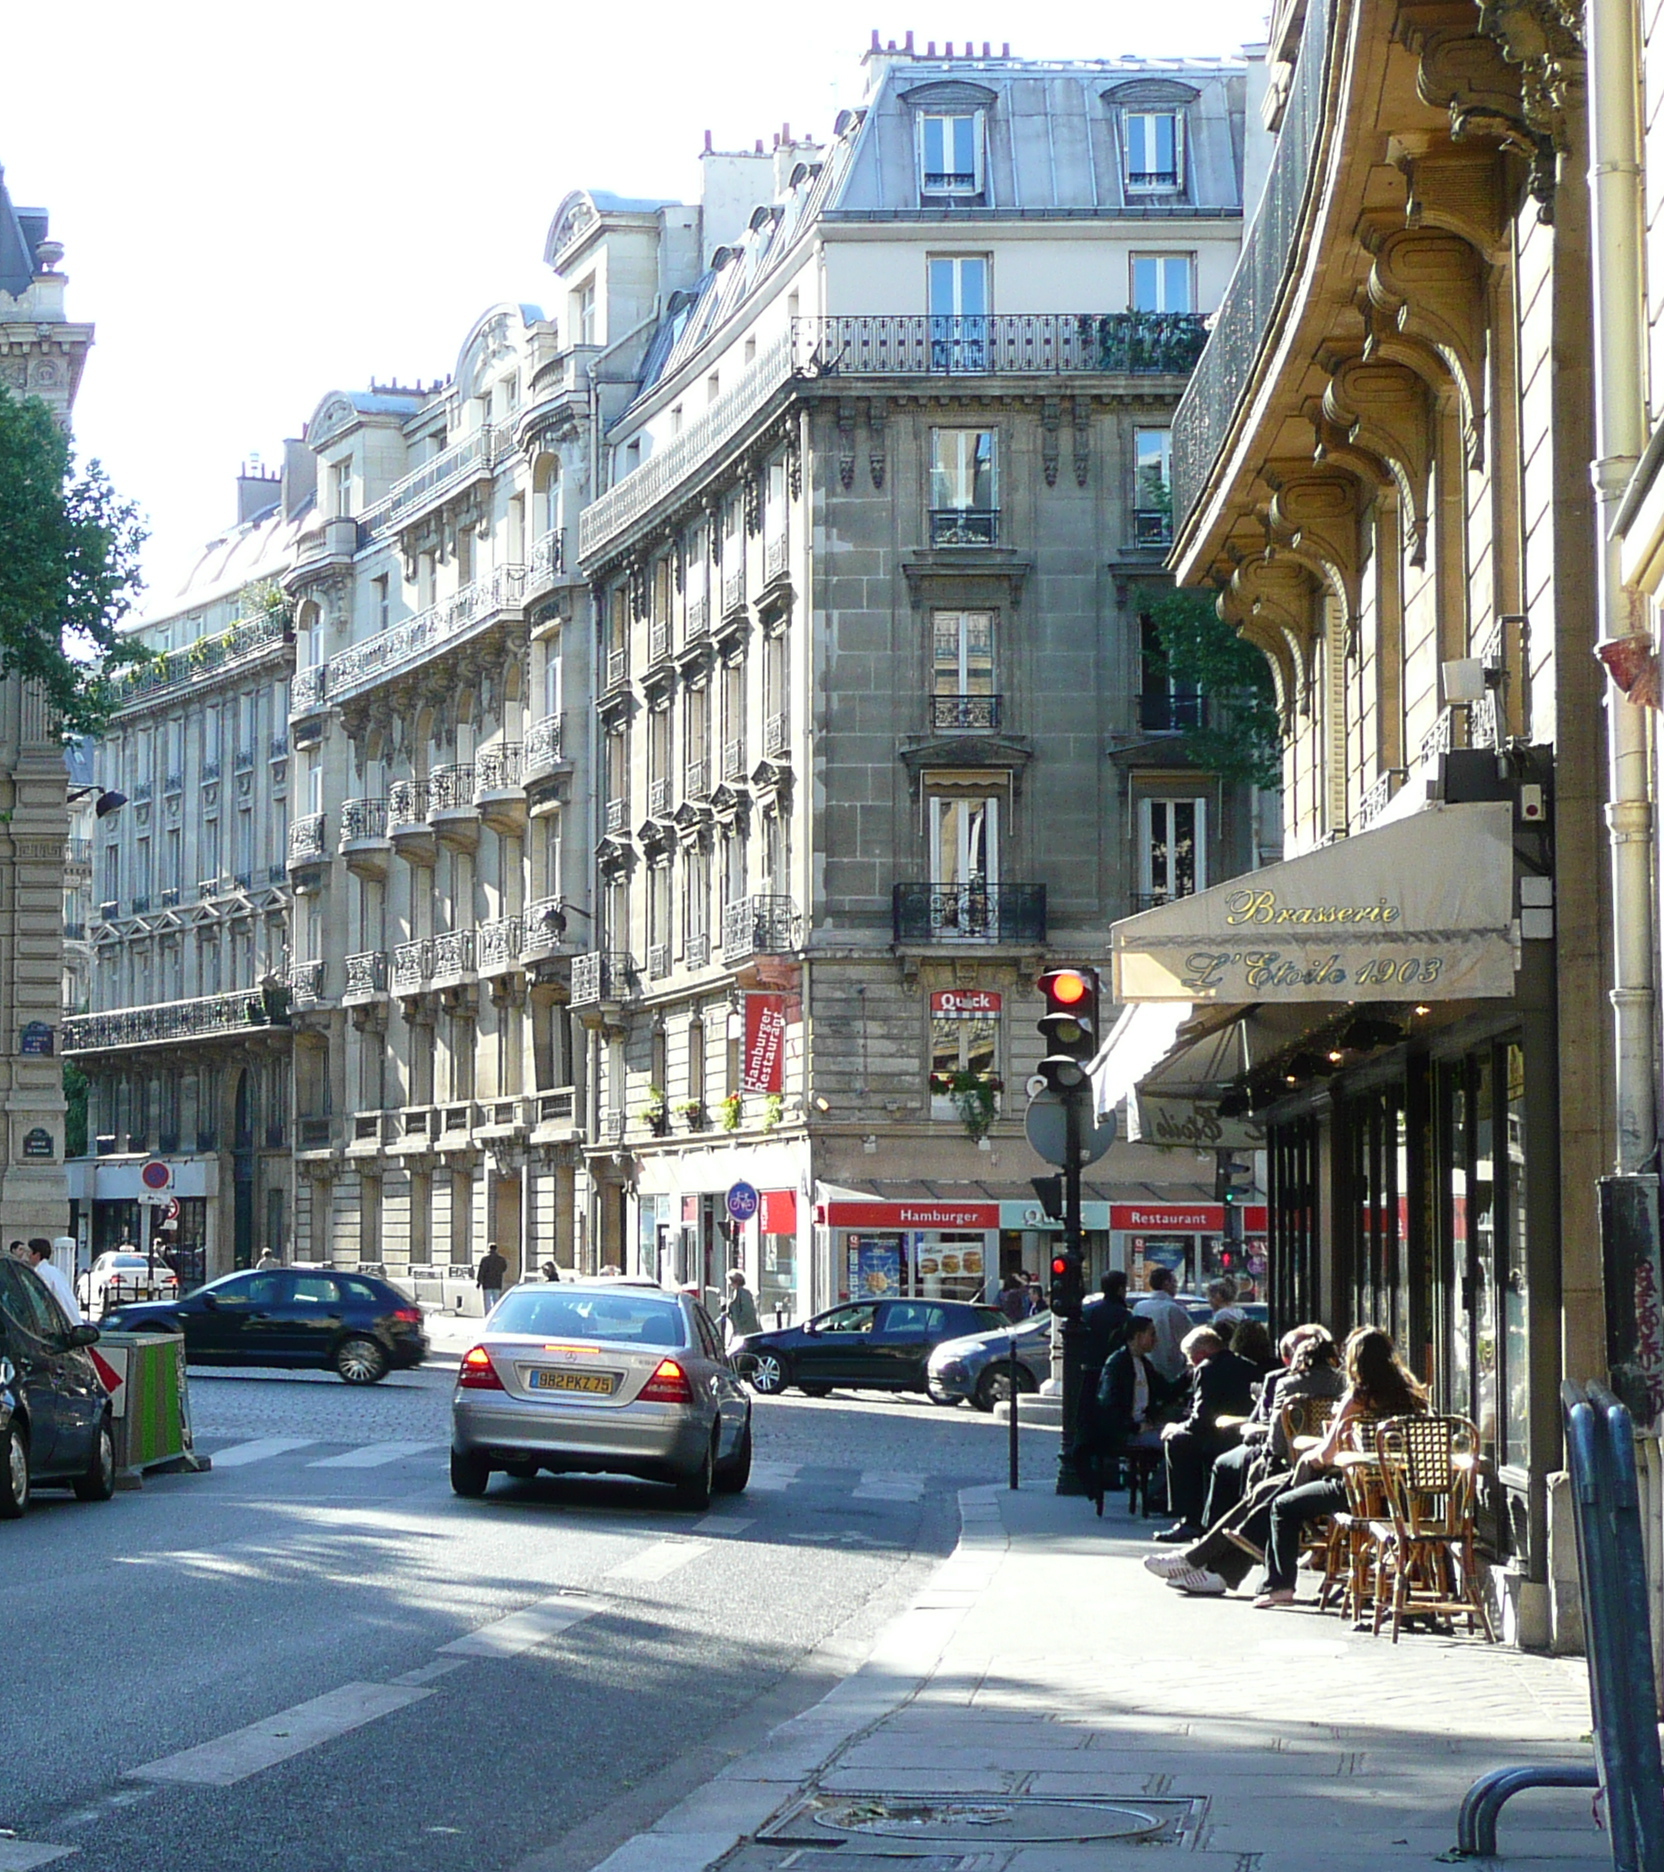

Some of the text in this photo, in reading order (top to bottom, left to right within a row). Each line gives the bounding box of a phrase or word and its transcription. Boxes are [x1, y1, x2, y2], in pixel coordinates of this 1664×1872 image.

[1226, 888, 1401, 926] Brasserie
[1354, 957, 1443, 985] 1903
[940, 993, 991, 1011] Quck
[744, 1006, 772, 1091] Hamburger
[754, 1011, 783, 1093] Restaurant
[900, 1209, 979, 1225] Hamburger
[1131, 1211, 1207, 1225] Restaurant
[539, 1372, 610, 1391] 982 PKZ 75
